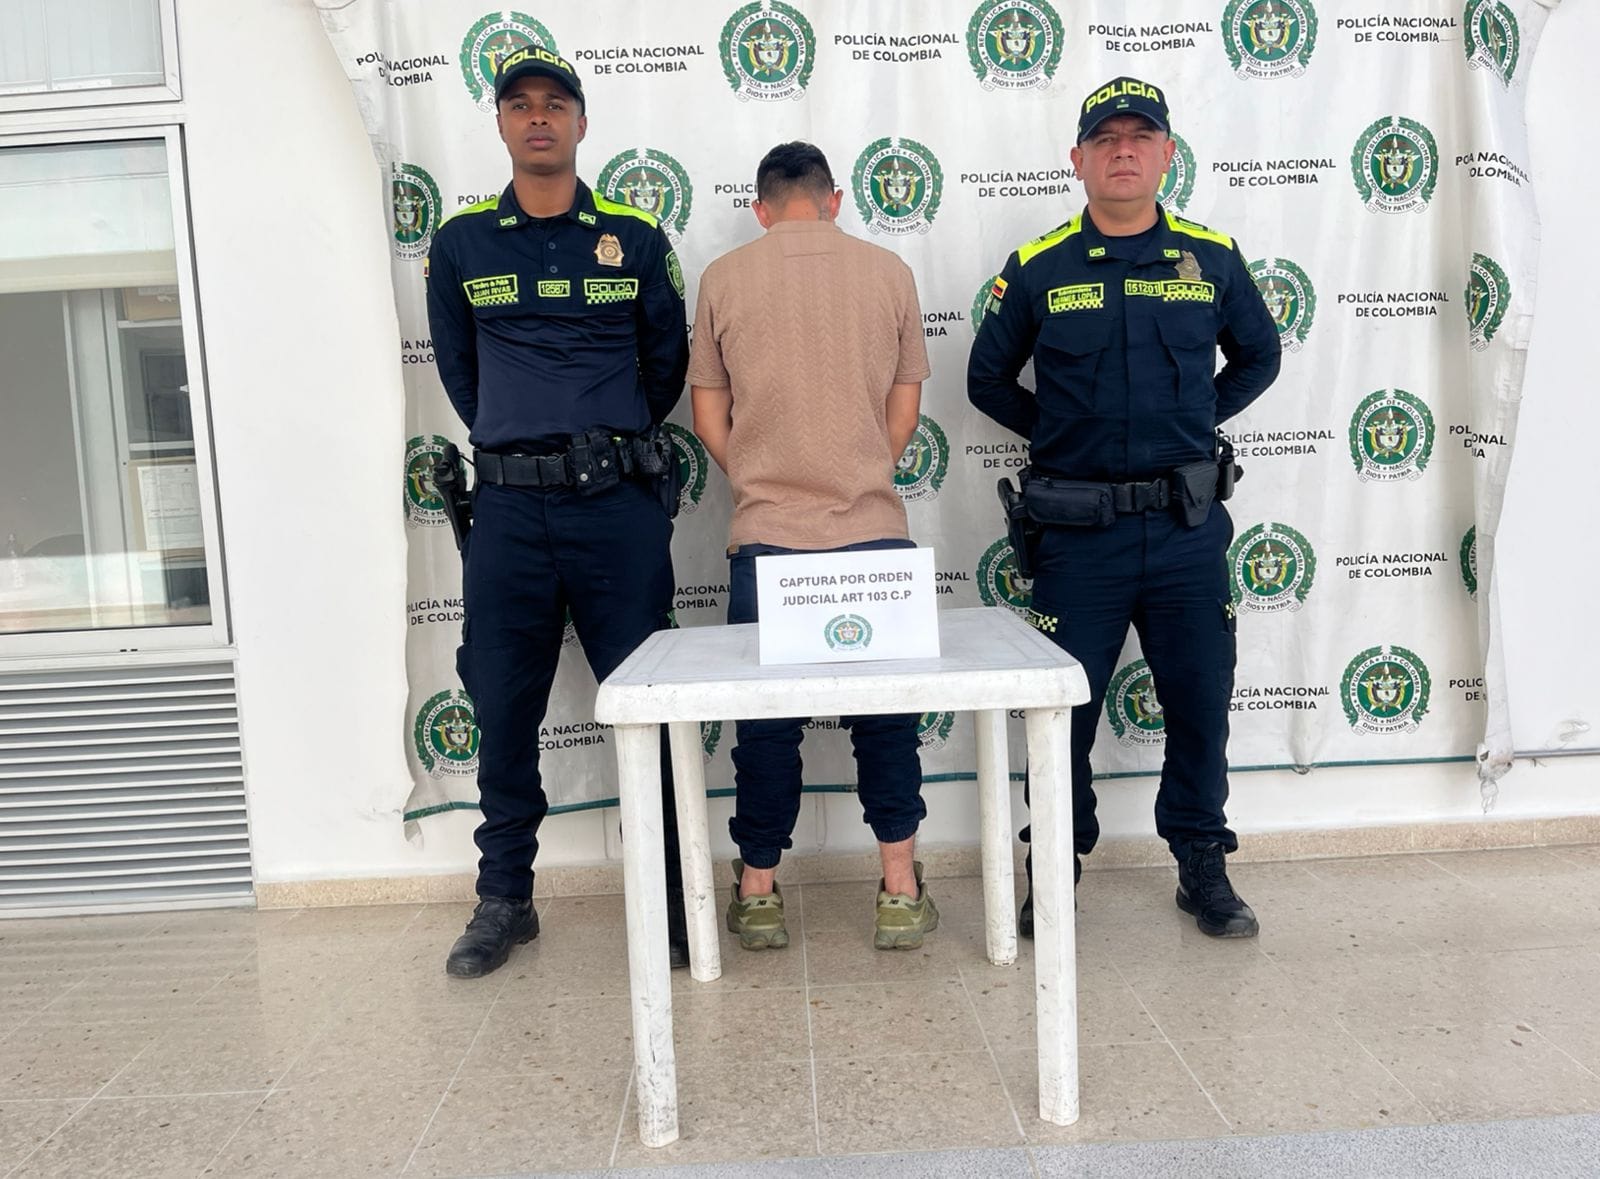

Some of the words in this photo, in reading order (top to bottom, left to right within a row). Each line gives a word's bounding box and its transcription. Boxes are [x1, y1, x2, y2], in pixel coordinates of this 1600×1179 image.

[1337, 15, 1390, 29] POLICÍA
[1393, 17, 1457, 28] NACIONAL
[1089, 24, 1136, 37] POLICÍA
[1140, 22, 1212, 37] NACIONAL
[835, 33, 886, 46] POLICÍA
[890, 34, 959, 47] NACIONAL
[1355, 33, 1372, 43] DE
[1377, 32, 1439, 43] COLOMBIA
[1106, 40, 1120, 51] DE
[1124, 38, 1195, 52] COLOMBIA
[576, 46, 629, 61] POLICÍA
[633, 45, 704, 58] NACIONAL
[853, 50, 869, 60] DE
[873, 49, 941, 62] COLOMBIA
[595, 65, 612, 74] DE
[616, 61, 687, 74] COLOMBIA
[1085, 81, 1159, 113] POLICÍA
[1213, 159, 1262, 172] POLICÍA
[1267, 159, 1336, 171] NACIONAL
[961, 170, 1013, 184] POLICÍA
[1230, 177, 1245, 187] DE
[1248, 174, 1318, 186] COLOMBIA
[979, 188, 995, 197] DE
[1000, 184, 1071, 197] COLOMBIA
[733, 199, 750, 208] DE
[1338, 292, 1384, 304] POLICÍA
[1387, 292, 1449, 304] NACIONAL
[1355, 307, 1370, 318] DE
[1372, 306, 1437, 317] COLOMBIA
[1267, 429, 1336, 442] NACIONAL
[966, 442, 1018, 455] POLICÍA
[1252, 445, 1317, 457] COLOMBIA
[984, 459, 1000, 468] DE
[1336, 552, 1379, 566] POLICÍA
[1382, 552, 1448, 564] NACIONAL
[780, 575, 837, 587] CAPTURA
[840, 574, 865, 585] POR
[869, 572, 913, 583] ORDEN
[1349, 568, 1361, 579] DE
[1364, 567, 1432, 578] COLOMBIA
[782, 594, 838, 606] JUDICIAL
[841, 593, 864, 603] ART
[869, 591, 887, 602] 103
[891, 590, 912, 600] C.P
[411, 615, 424, 625] DE
[1264, 685, 1330, 697] NACIONAL
[1465, 691, 1480, 701] DE
[1230, 702, 1244, 711] DE
[1247, 700, 1317, 710] COLOMBIA
